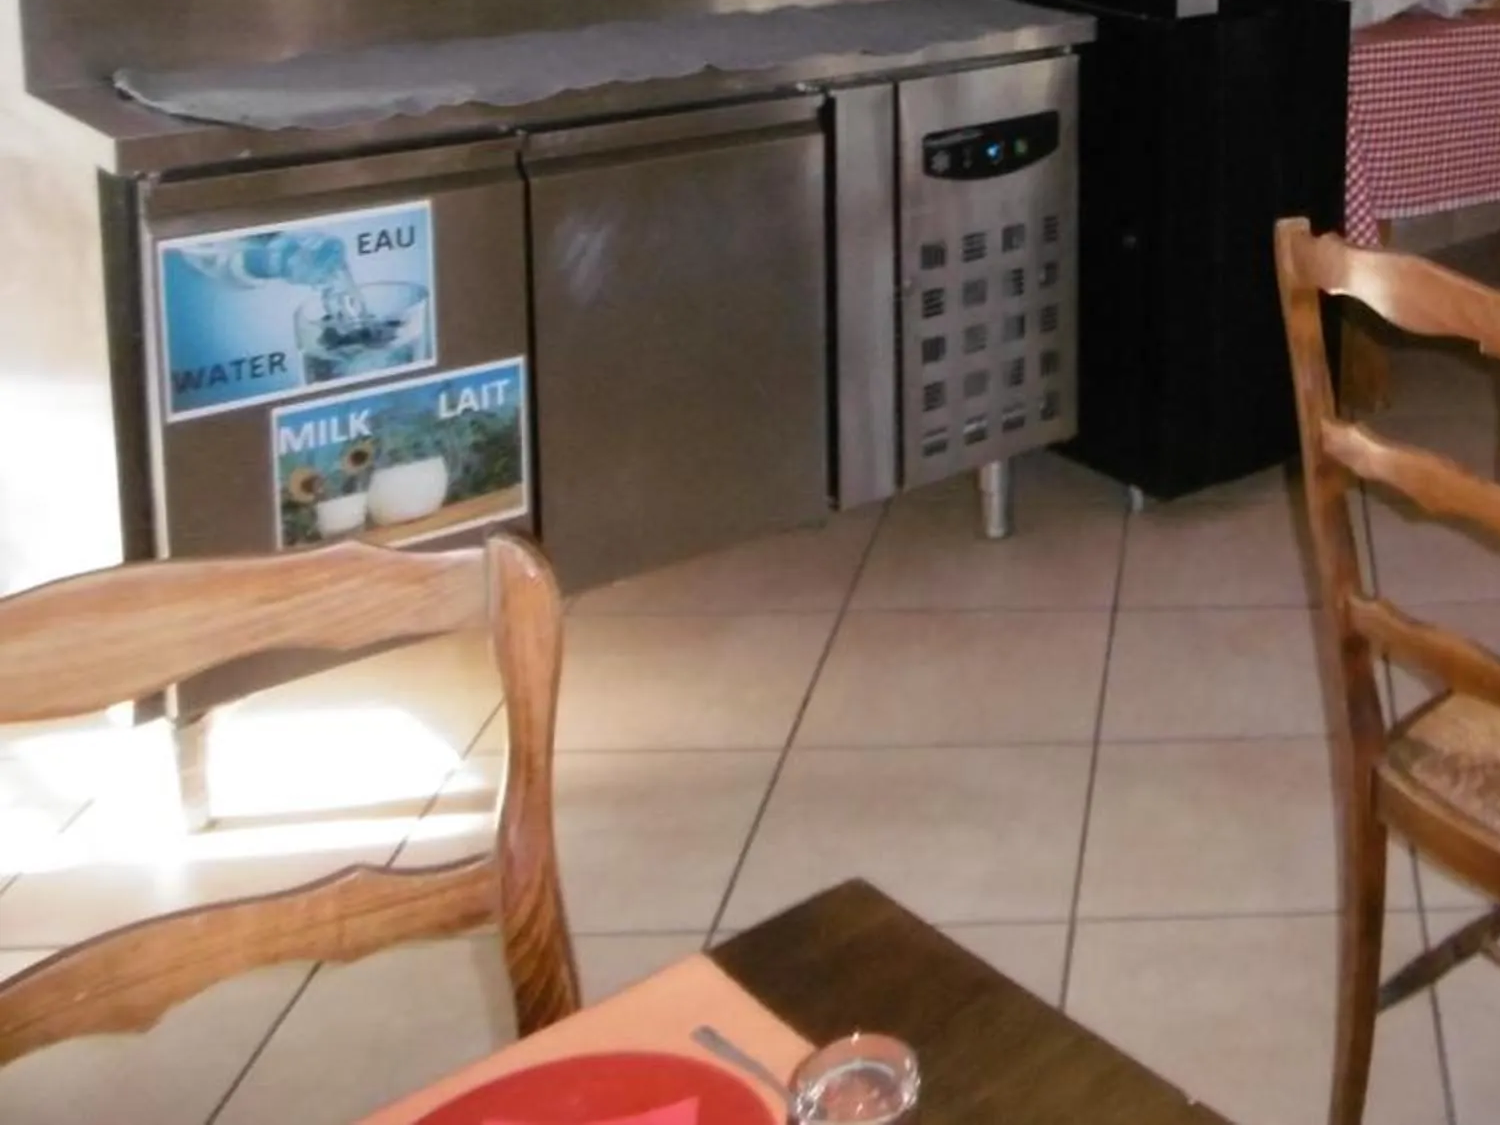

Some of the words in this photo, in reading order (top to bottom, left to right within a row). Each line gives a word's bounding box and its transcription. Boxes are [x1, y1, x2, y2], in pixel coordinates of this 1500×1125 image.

[357, 225, 416, 256] EAU
[172, 351, 288, 394] WATER
[279, 409, 372, 454] MILK
[438, 379, 510, 419] LAIT
